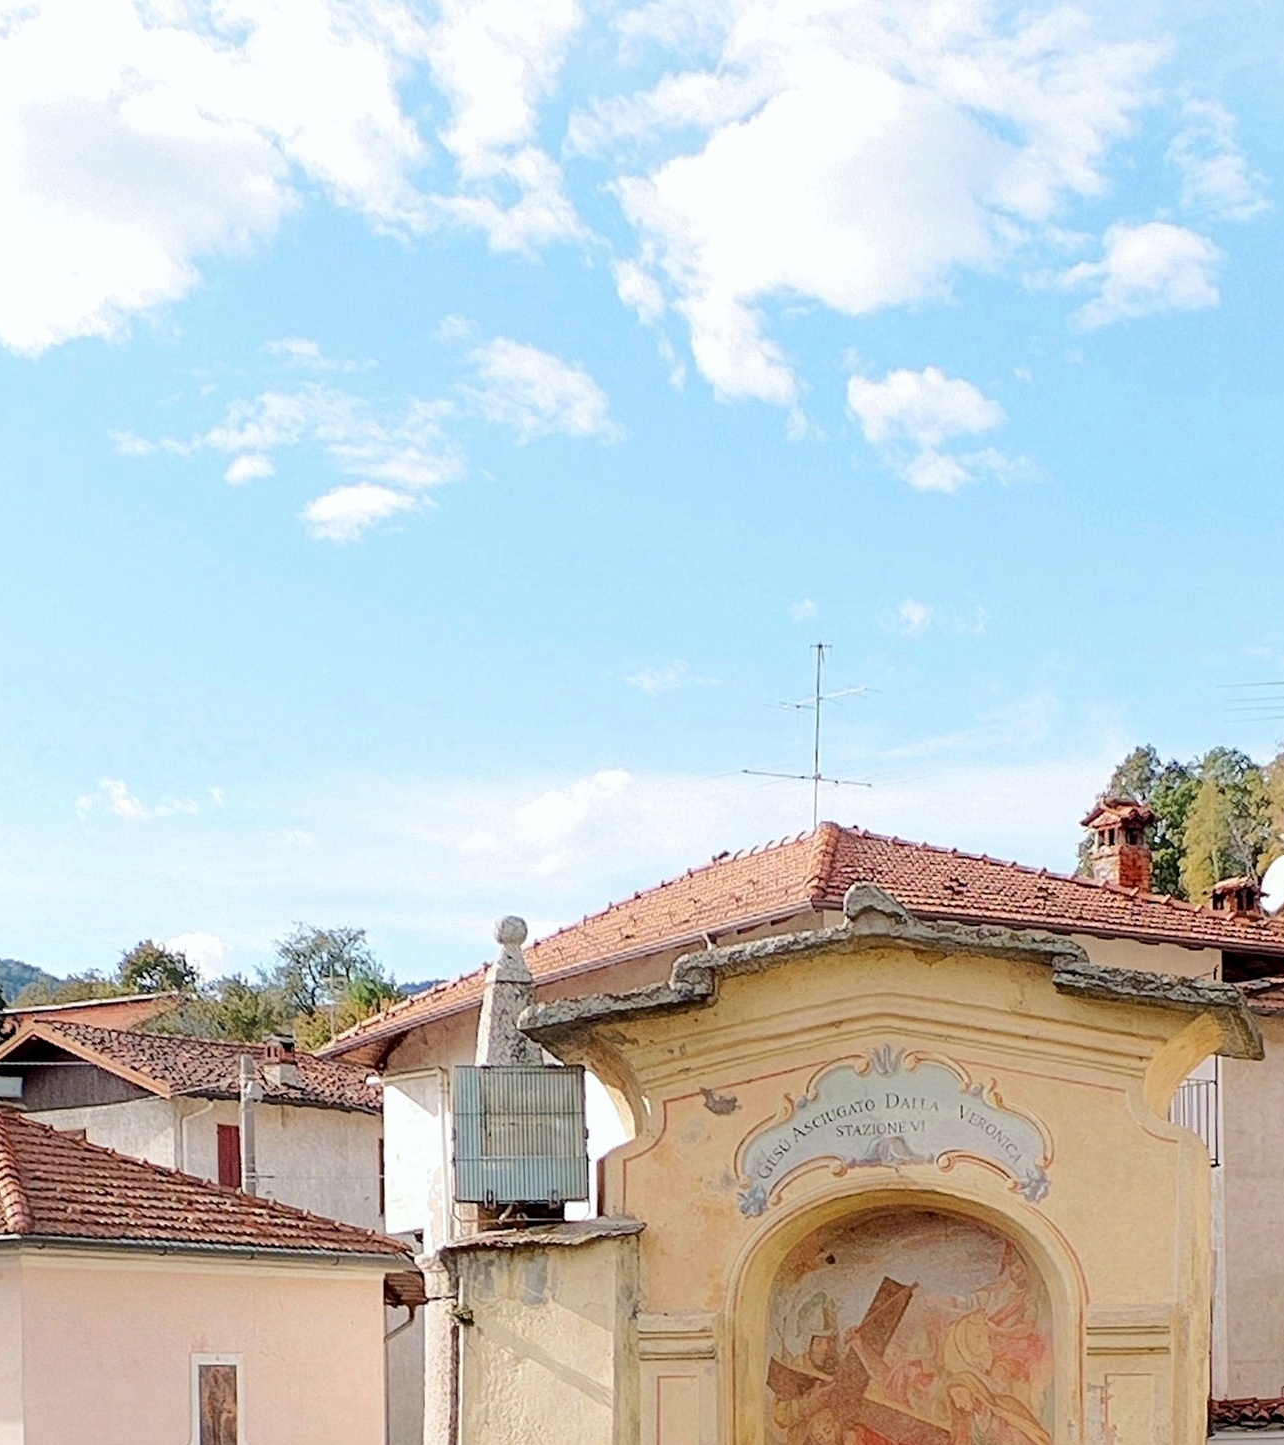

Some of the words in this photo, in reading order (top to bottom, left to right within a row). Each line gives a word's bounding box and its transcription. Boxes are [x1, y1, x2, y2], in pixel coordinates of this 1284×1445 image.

[793, 1098, 875, 1143] ASCIUGATO
[885, 1092, 939, 1112] DALLA
[960, 1104, 1022, 1164] VERONICA
[836, 1121, 907, 1138] STAZIONE
[911, 1121, 925, 1132] VI
